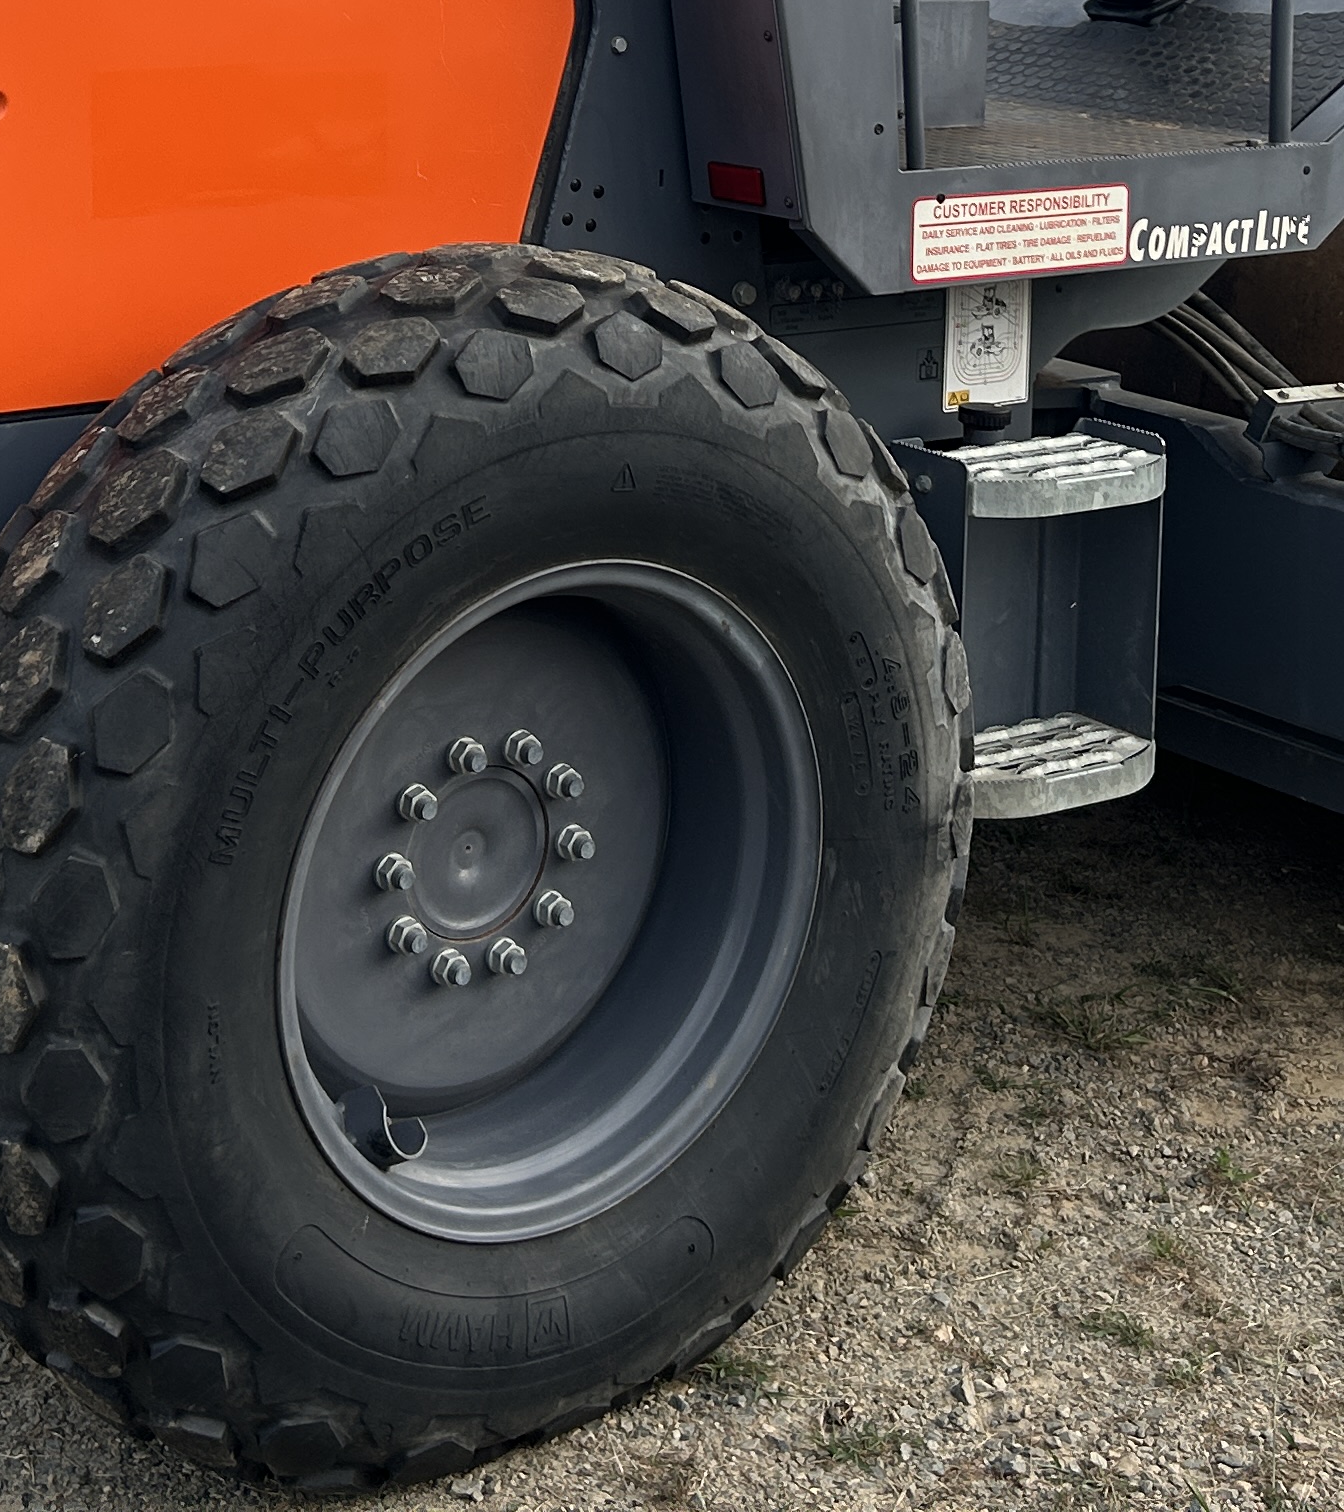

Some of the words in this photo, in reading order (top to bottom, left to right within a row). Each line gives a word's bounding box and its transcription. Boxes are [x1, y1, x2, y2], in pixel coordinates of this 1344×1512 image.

[933, 201, 1006, 219] CUSTOMER
[1009, 193, 1111, 214] RESPONSIBILITY
[921, 229, 944, 239] DAILY
[945, 226, 978, 238] SERVICE
[979, 225, 996, 235] AND
[996, 222, 1034, 234] CLEANING
[1040, 217, 1088, 230] LUBRICATION
[1092, 215, 1120, 226] FILTERS
[925, 244, 970, 257] INSURANCE
[975, 242, 994, 253] FLAT
[995, 240, 1017, 250] TIRES
[1022, 237, 1039, 248] TIRE
[1040, 235, 1071, 246] DAMAGE
[1076, 231, 1116, 243] REFUELING
[916, 262, 950, 274] DAMAGE
[952, 261, 962, 271] TO
[963, 257, 1007, 270] EQUIPMENT
[1012, 254, 1045, 265] BATTERY
[1050, 252, 1064, 262] ALL
[1065, 250, 1082, 261] OILS
[1083, 248, 1098, 258] AND
[1099, 247, 1124, 257] FLUIDS
[207, 493, 493, 867] MULTI-PURPOSE
